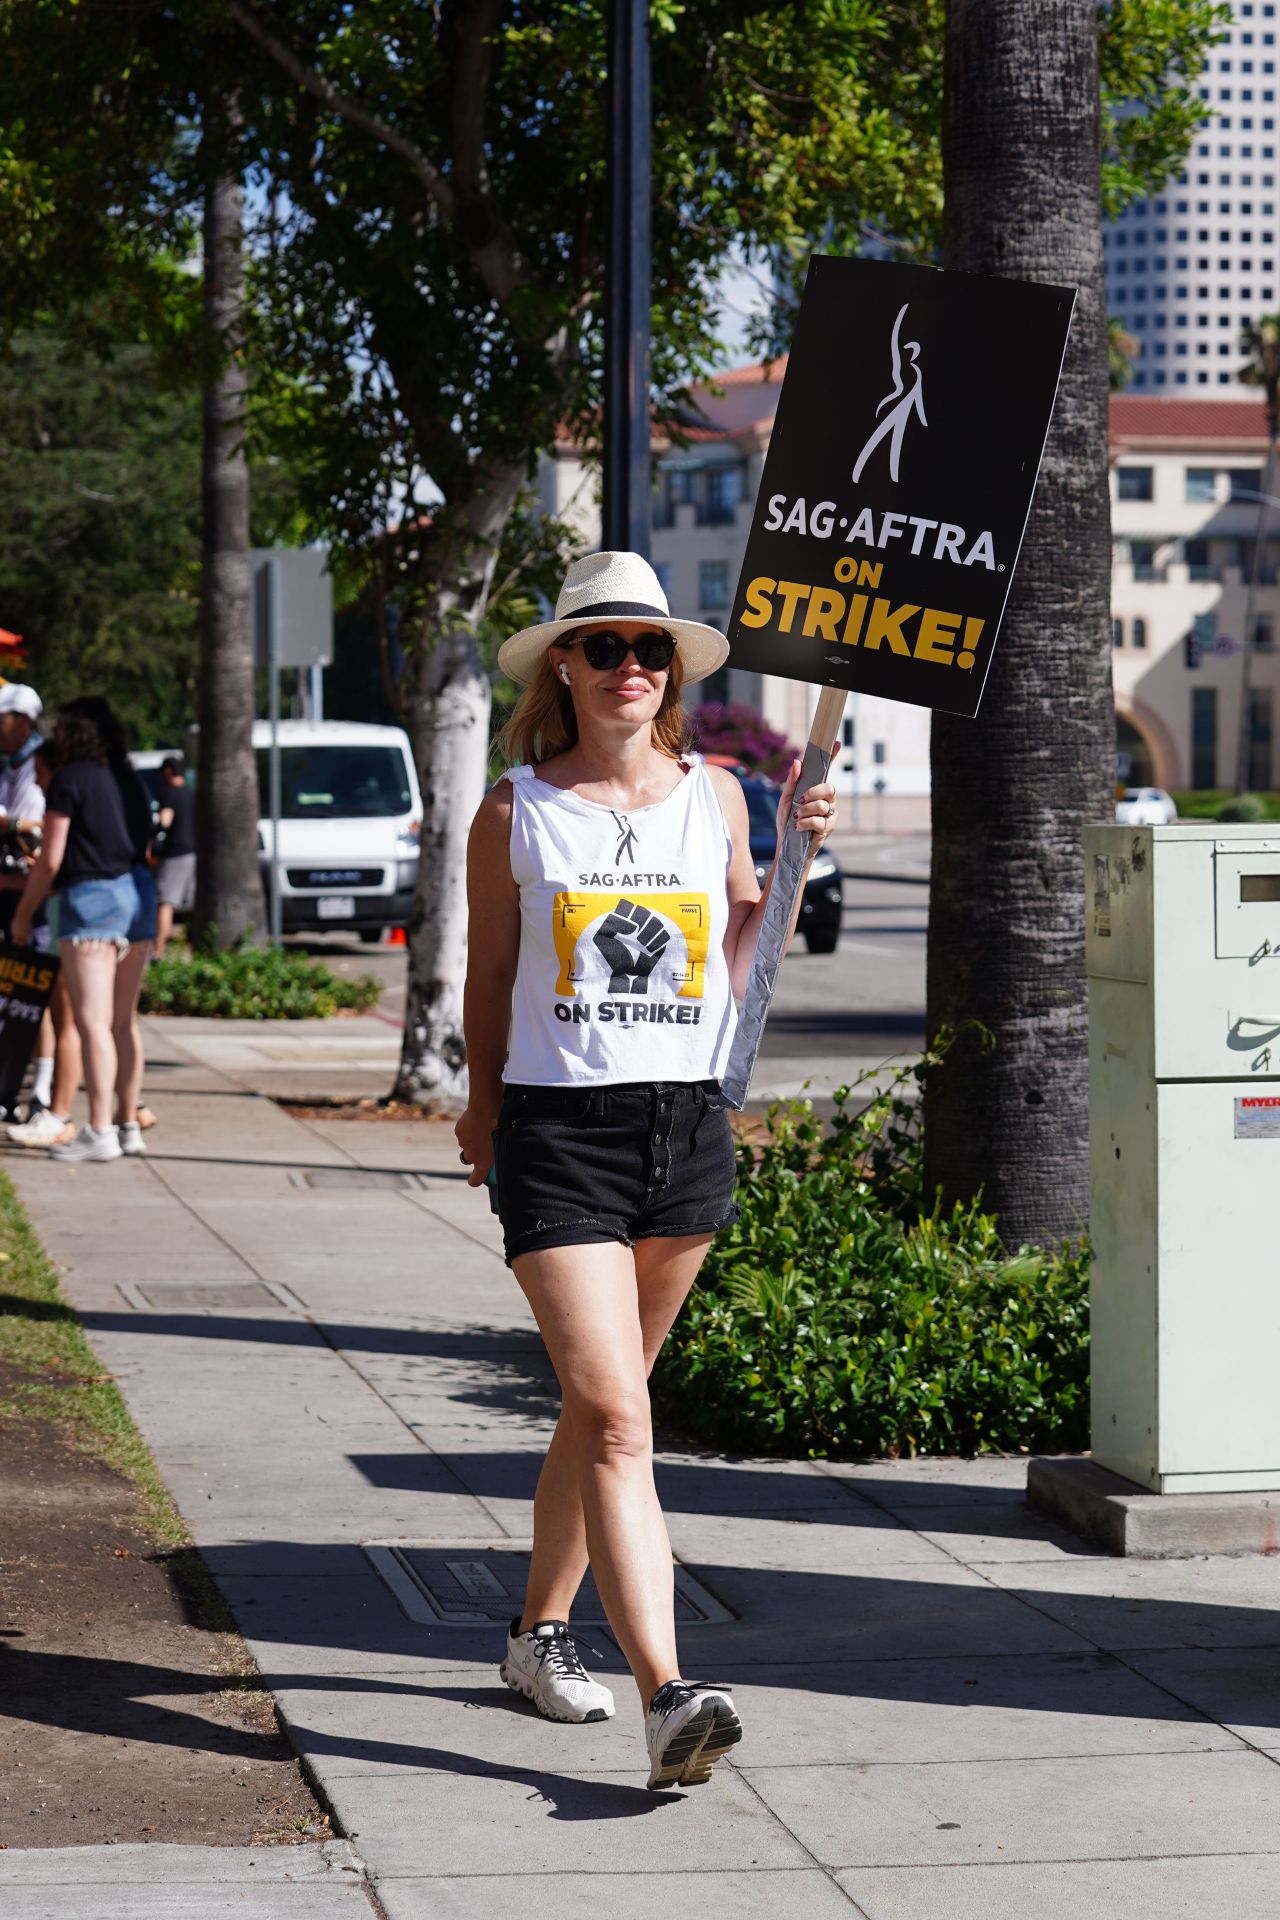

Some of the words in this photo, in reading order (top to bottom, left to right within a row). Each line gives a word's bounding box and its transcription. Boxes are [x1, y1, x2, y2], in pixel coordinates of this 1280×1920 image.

[833, 556, 884, 589] ON
[739, 576, 986, 670] STRIKE!
[554, 1002, 590, 1024] ON
[598, 1001, 702, 1025] STRIKE!
